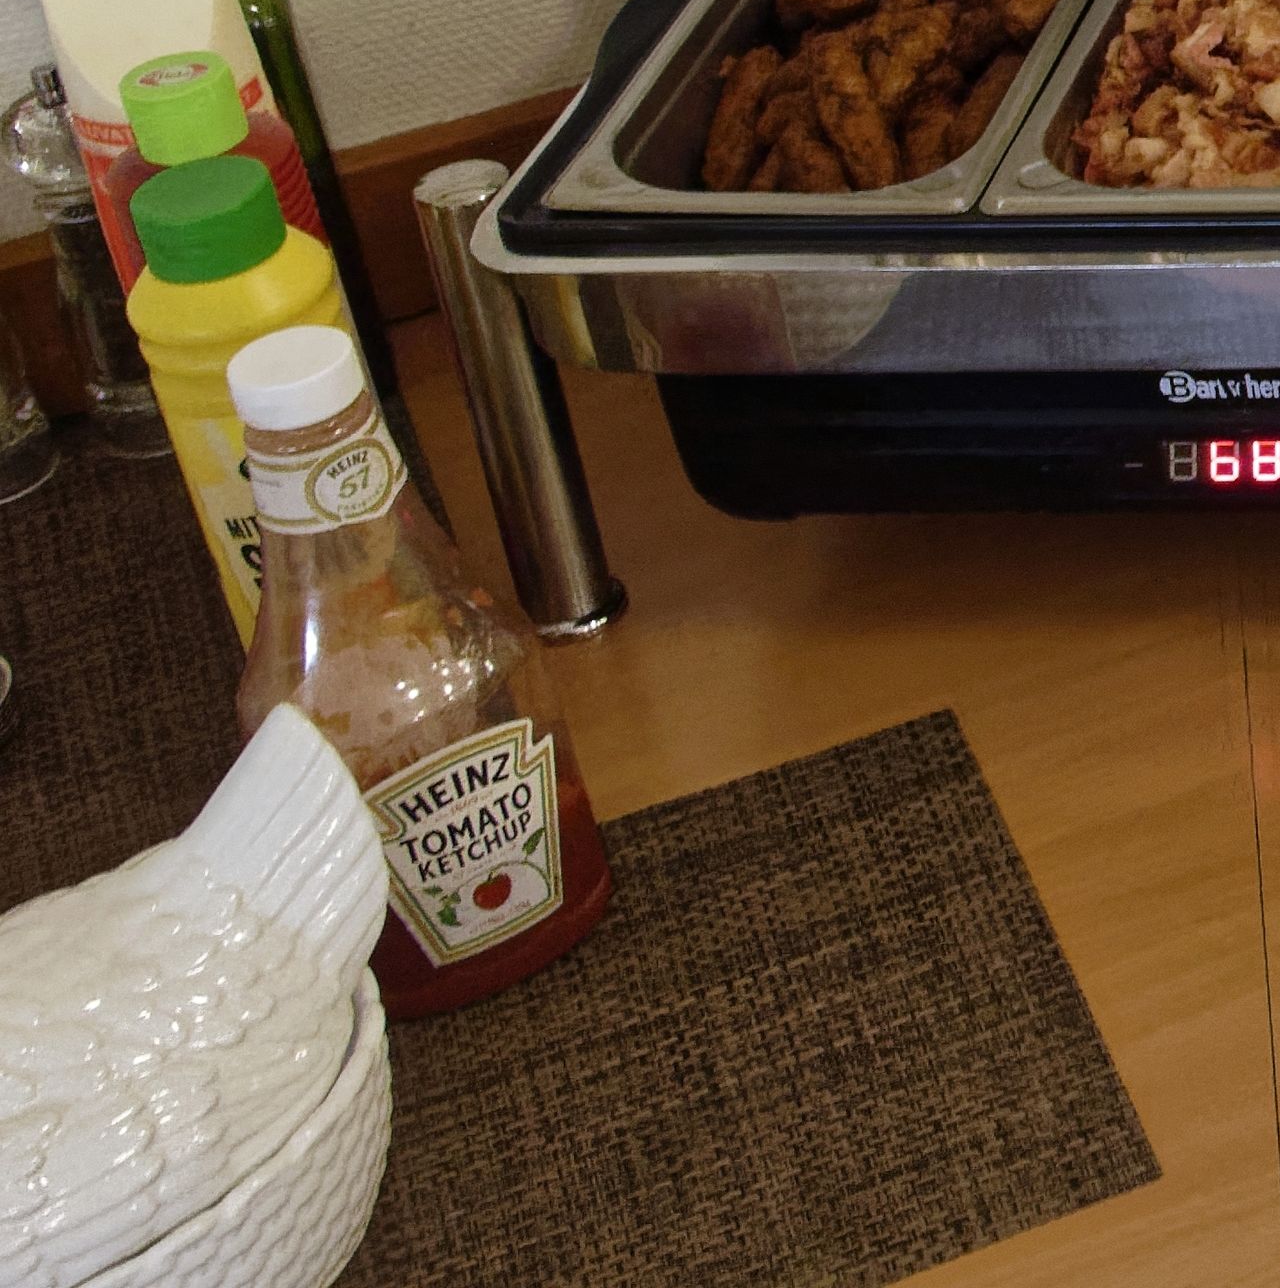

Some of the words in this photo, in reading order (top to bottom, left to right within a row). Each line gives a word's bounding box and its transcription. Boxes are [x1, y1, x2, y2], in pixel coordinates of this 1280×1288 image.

[1159, 370, 1280, 403] Barther
[326, 450, 368, 479] HEINZ
[339, 465, 370, 499] 57
[400, 752, 510, 823] HEINZ
[400, 782, 532, 863] TOMATO
[418, 810, 532, 883] KETCHUP
